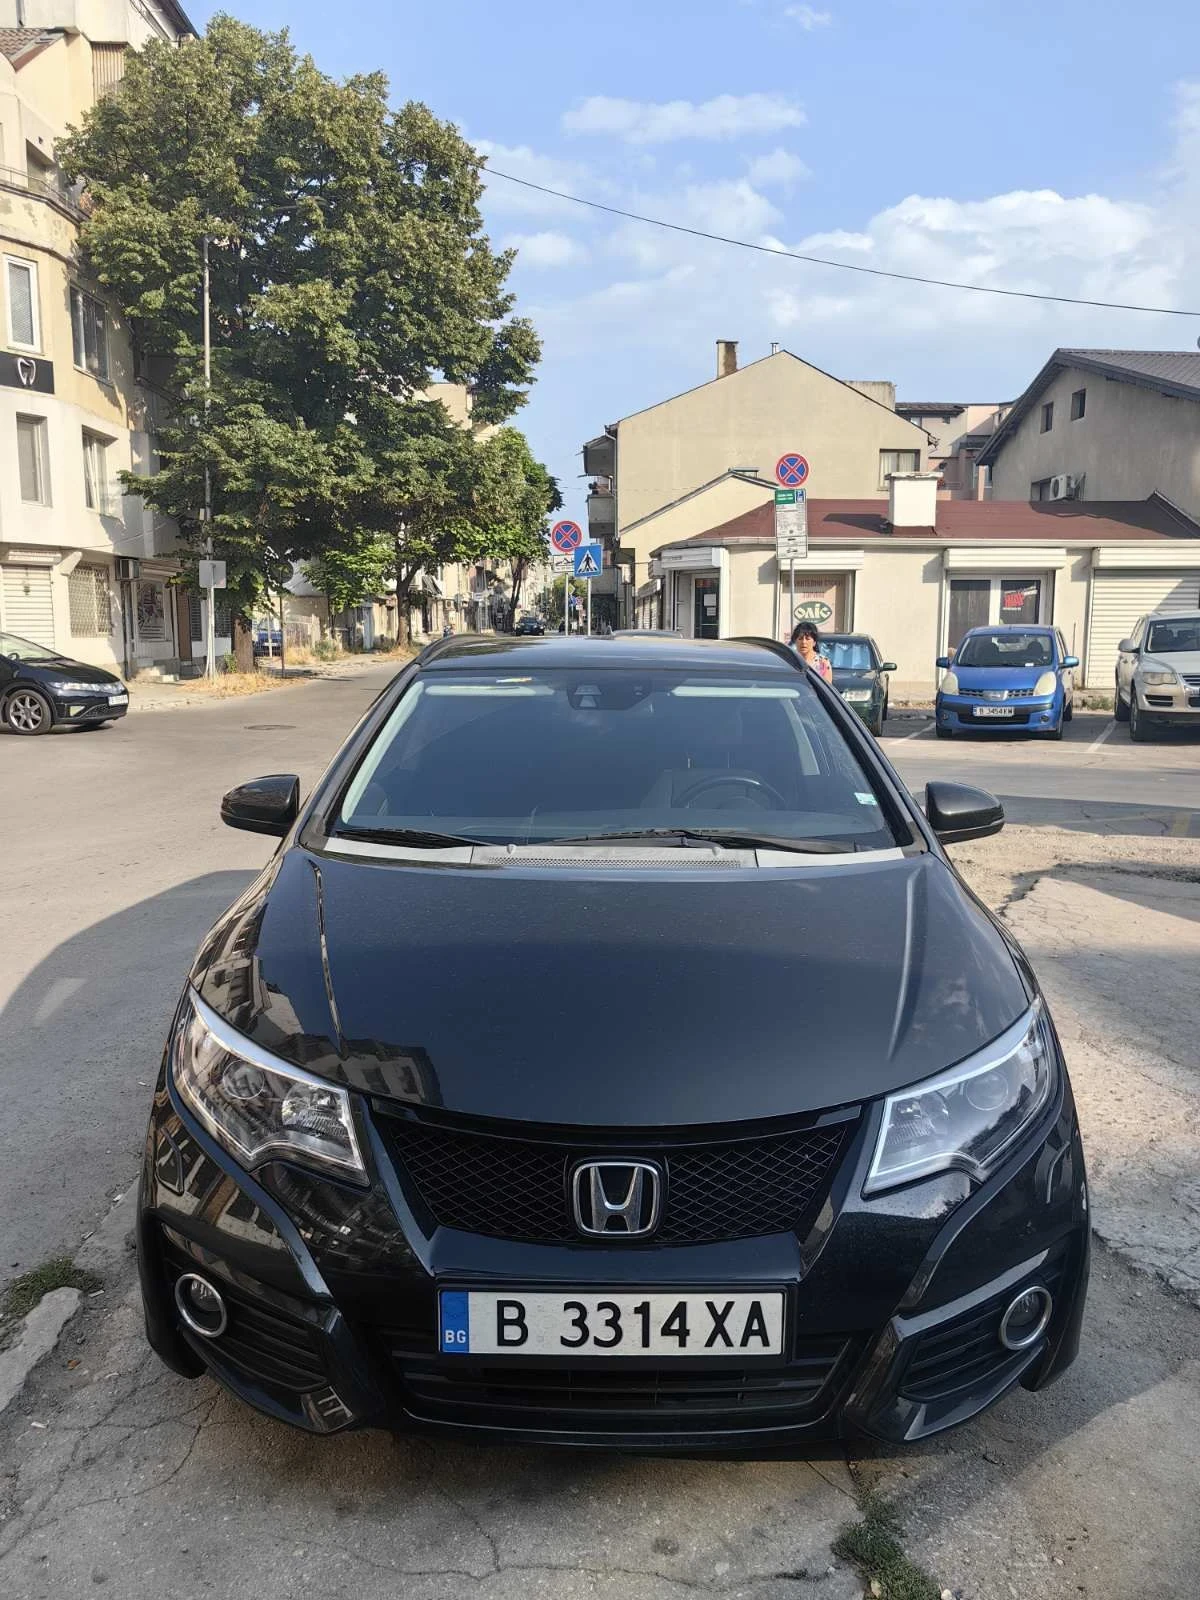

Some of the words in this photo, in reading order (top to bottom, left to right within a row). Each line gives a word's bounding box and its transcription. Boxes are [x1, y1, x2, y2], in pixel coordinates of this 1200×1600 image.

[445, 1330, 466, 1343] BG
[497, 1300, 528, 1347] B
[560, 1301, 690, 1348] 3314
[704, 1301, 770, 1347] XA
